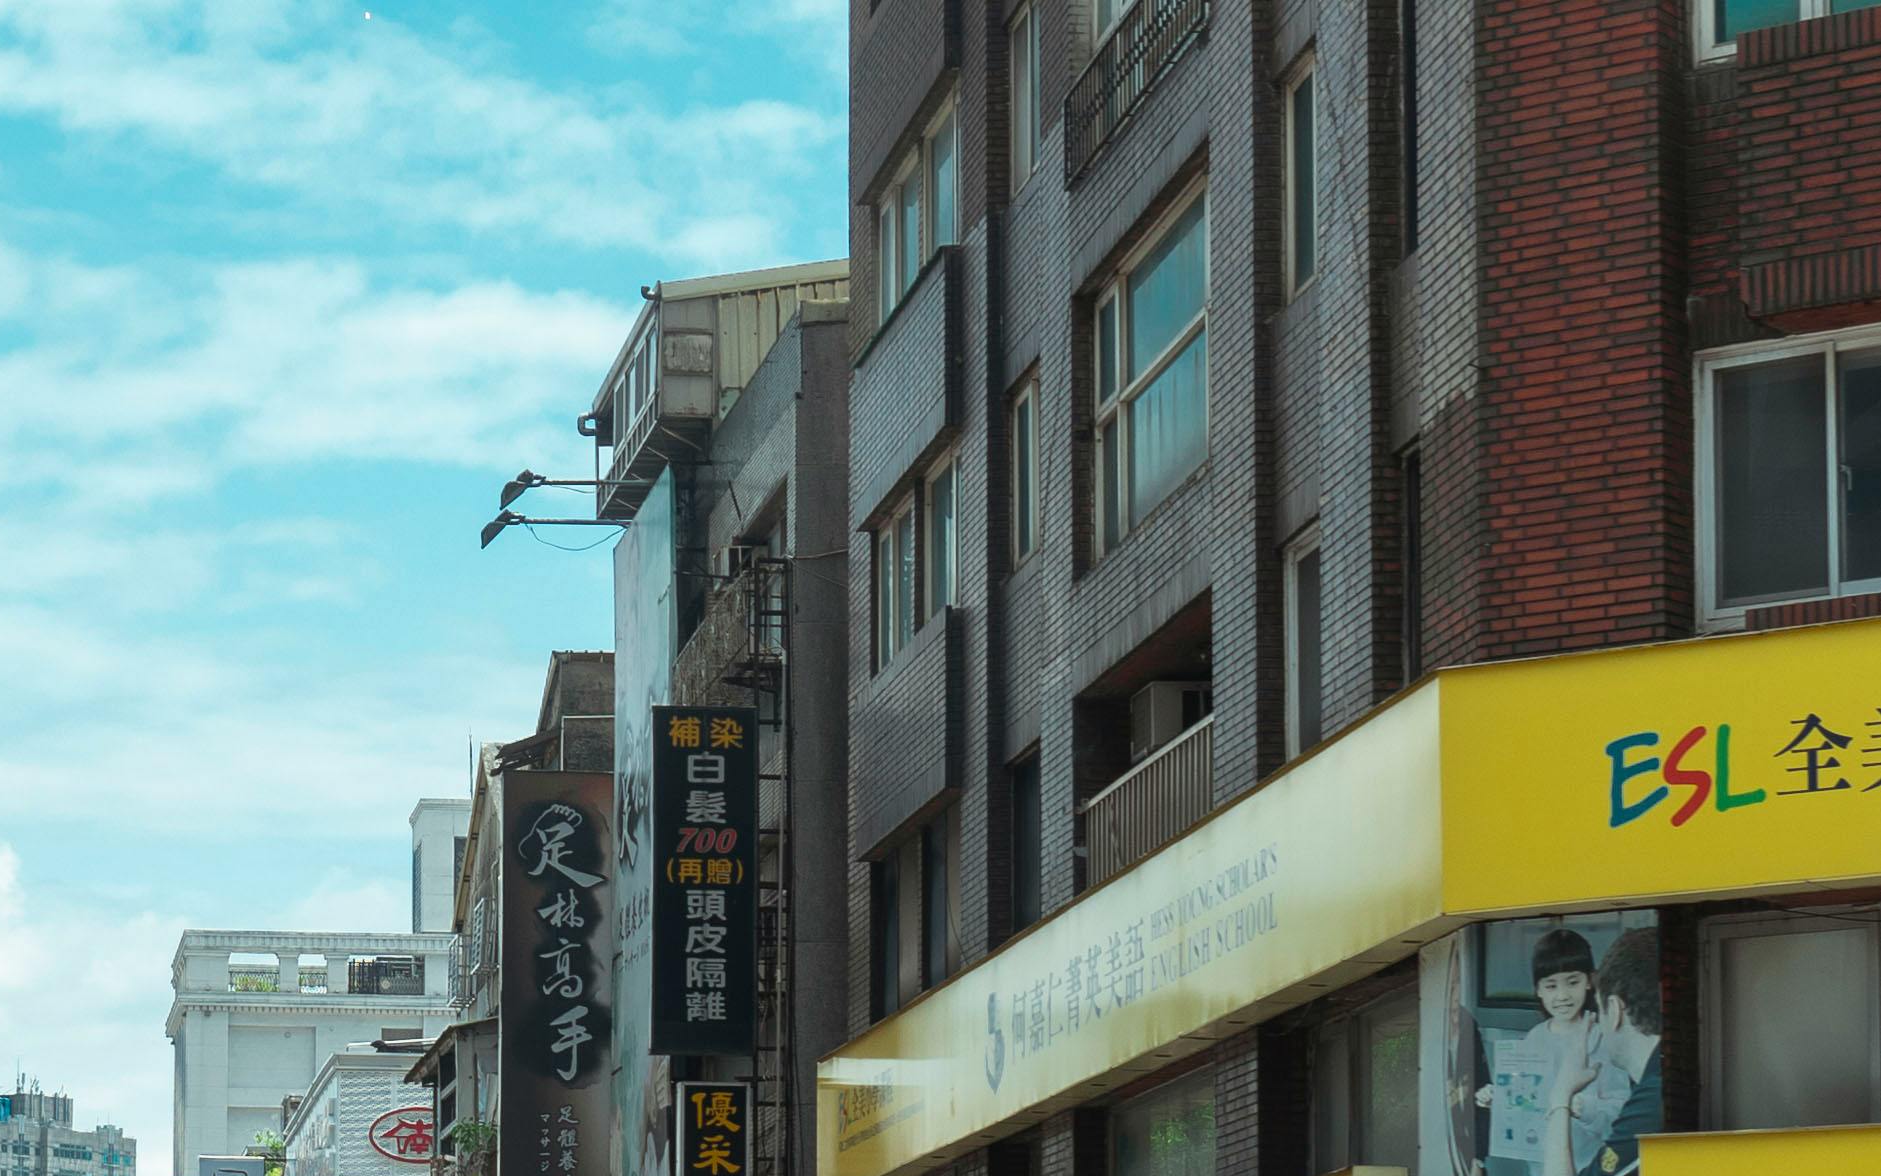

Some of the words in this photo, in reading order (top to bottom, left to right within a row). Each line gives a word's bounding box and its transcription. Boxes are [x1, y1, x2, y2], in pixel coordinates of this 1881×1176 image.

[669, 715, 744, 749] 補染
[1606, 723, 1766, 828] ESL
[685, 751, 727, 825] 白髮
[676, 828, 738, 854] 700
[685, 889, 727, 1022] 頭皮隔離
[1149, 930, 1212, 992] ENGLISH
[1216, 892, 1279, 958] SCHOOL
